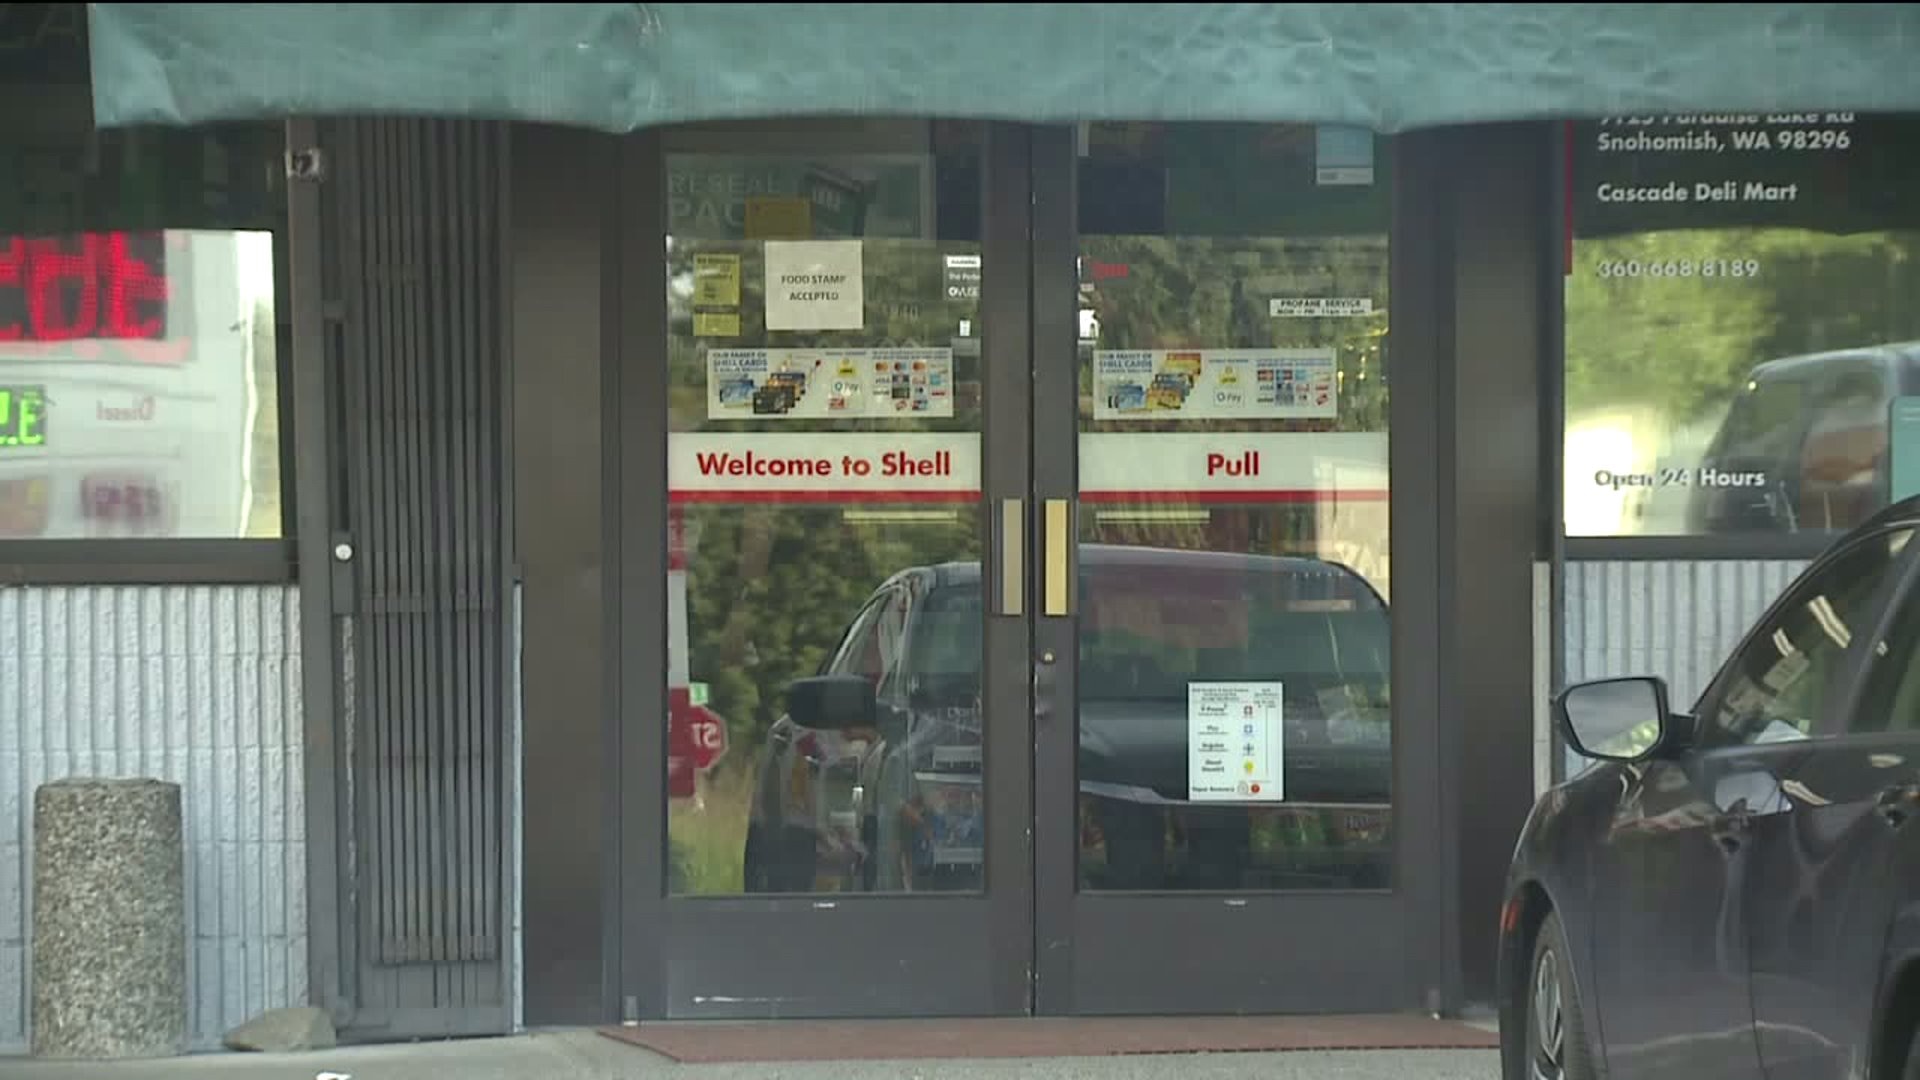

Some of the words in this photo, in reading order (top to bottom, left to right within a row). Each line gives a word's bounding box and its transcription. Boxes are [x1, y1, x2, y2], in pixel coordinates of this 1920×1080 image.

[1598, 130, 1726, 153] Snohomish,
[1732, 131, 1771, 149] WA
[1778, 130, 1851, 150] 98296
[1597, 183, 1688, 202] Cascade
[1695, 182, 1737, 201] Deli
[1744, 183, 1798, 201] Mart
[781, 275, 810, 285] FOOD
[811, 275, 847, 285] STAMP
[789, 291, 839, 301] ACCEPTED
[1280, 299, 1321, 308] PROPANE
[1325, 299, 1361, 308] SERVICE
[696, 453, 831, 477] Welcome
[843, 456, 870, 477] to
[881, 452, 951, 477] Shell
[1206, 452, 1260, 477] Pull
[1594, 470, 1653, 491] Open
[1661, 469, 1690, 487] 24
[1699, 469, 1765, 487] Hours
